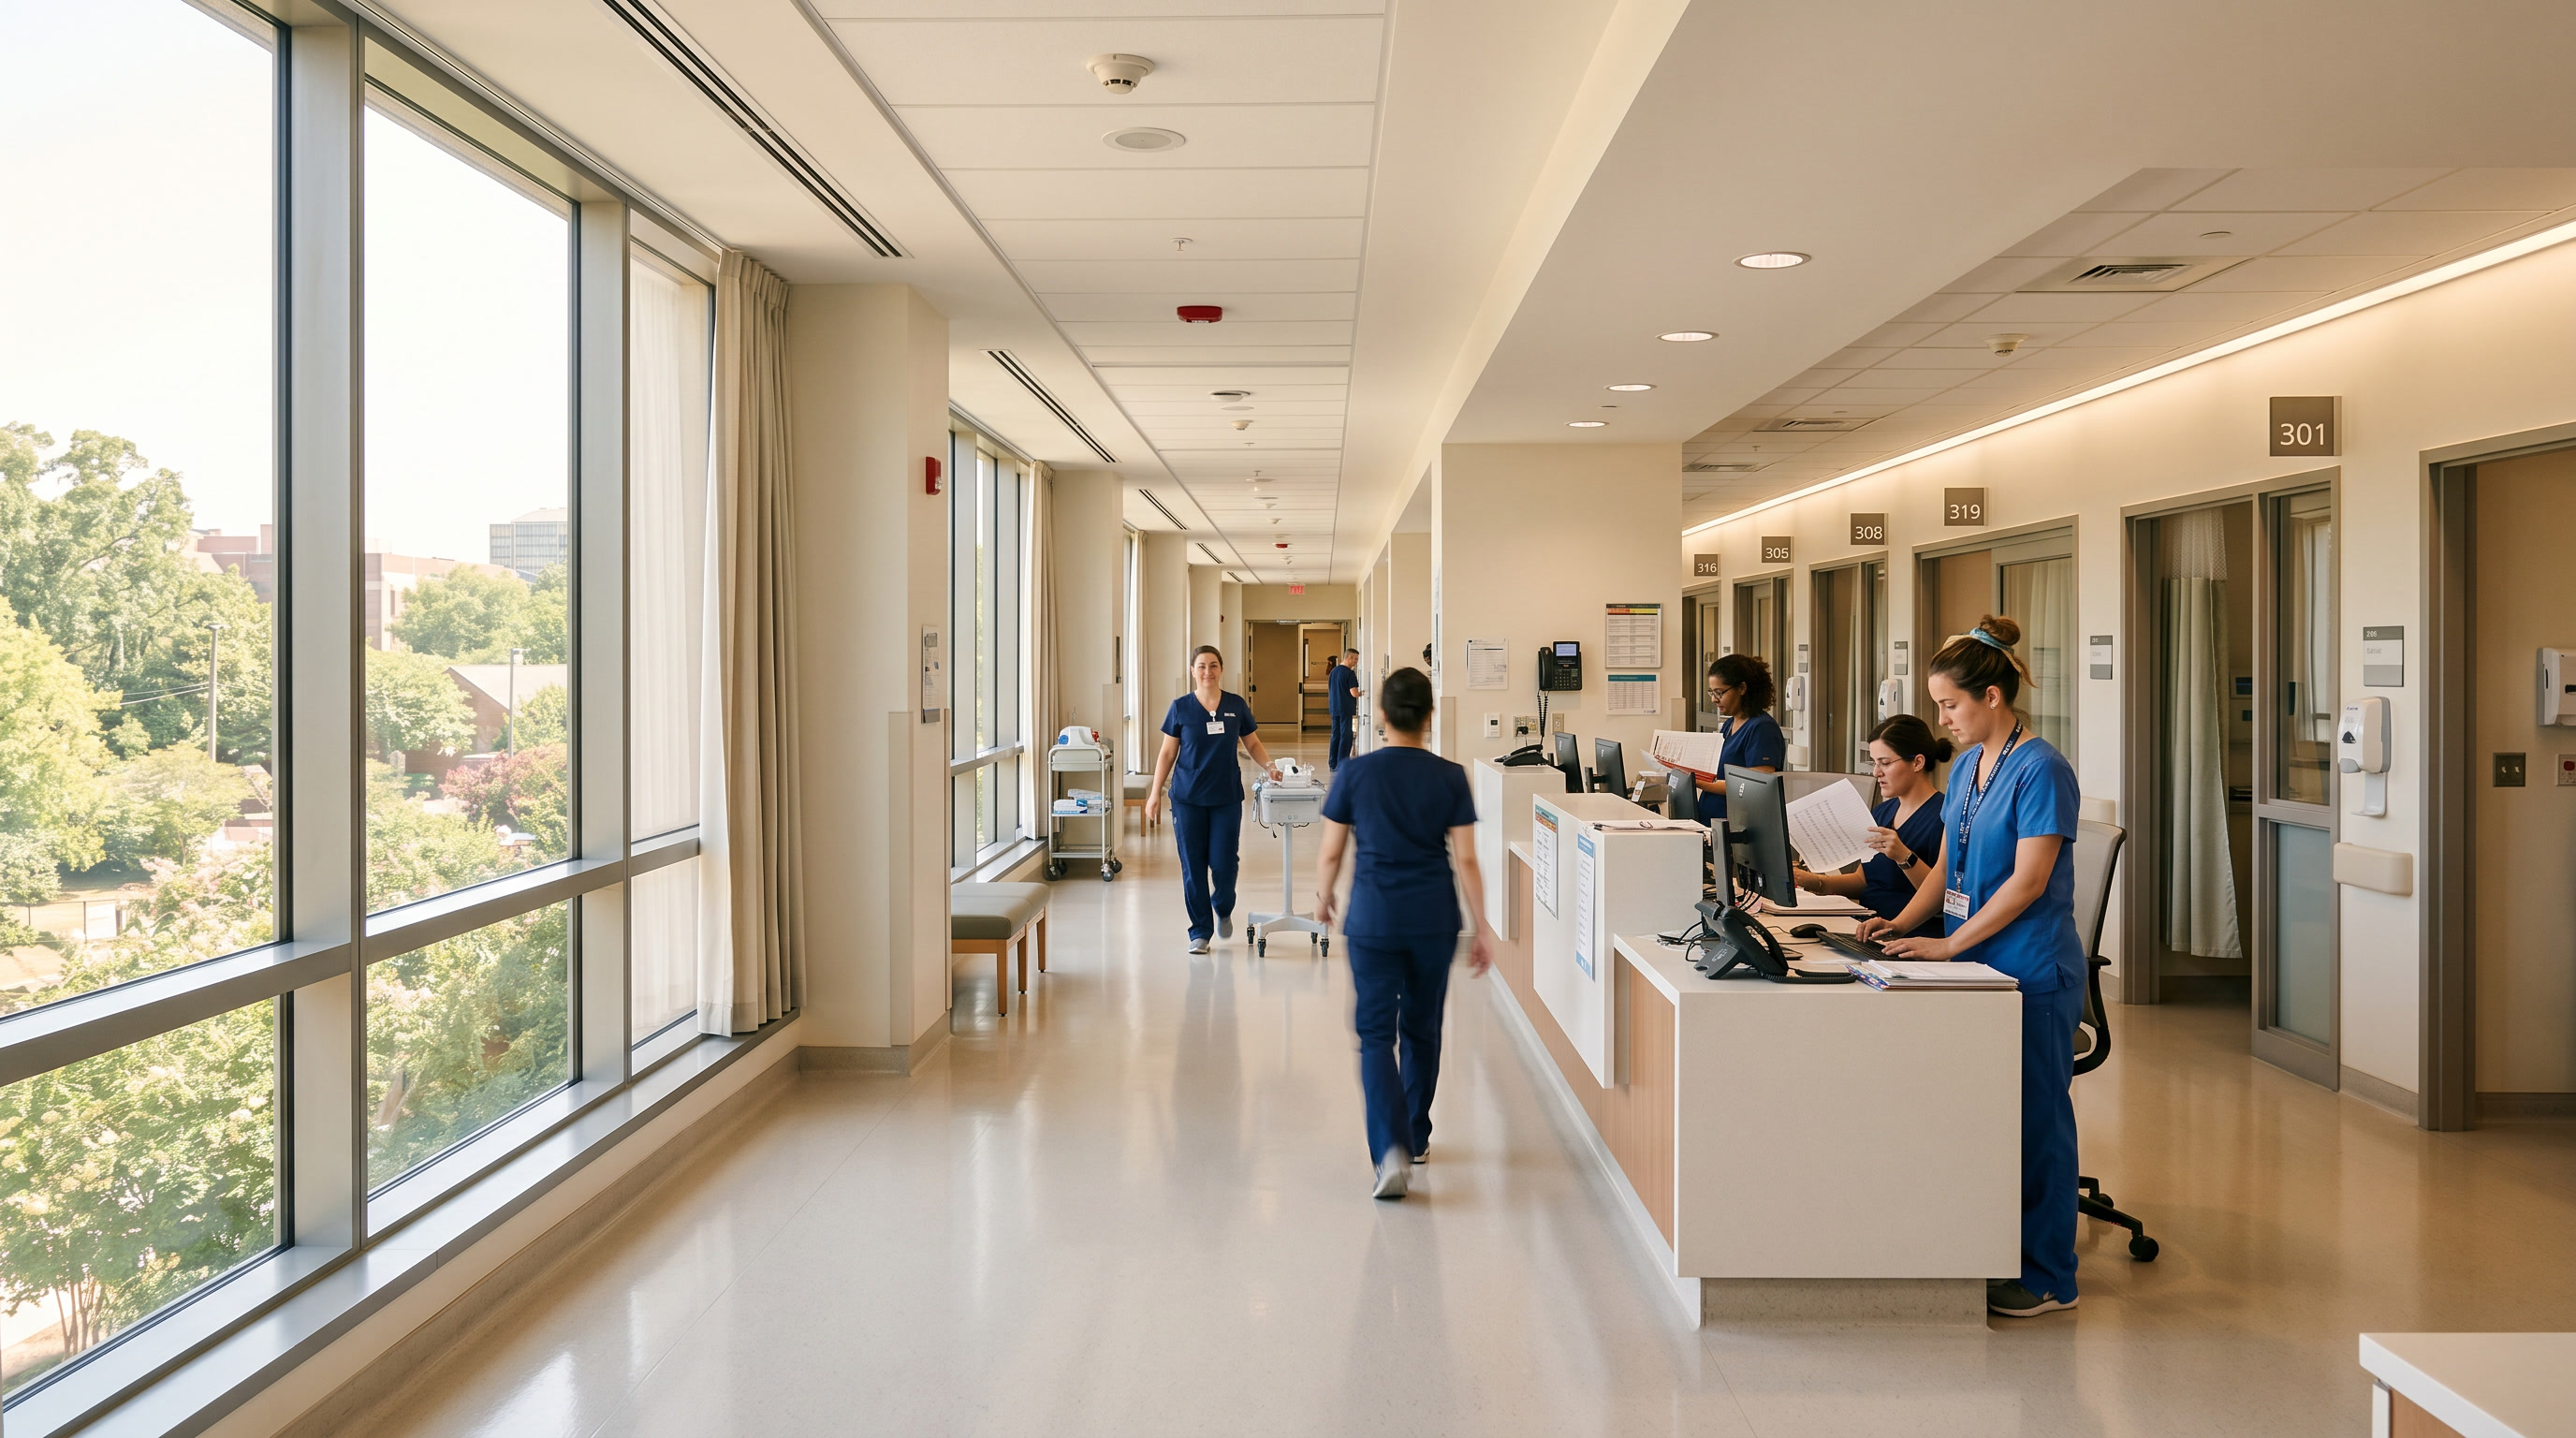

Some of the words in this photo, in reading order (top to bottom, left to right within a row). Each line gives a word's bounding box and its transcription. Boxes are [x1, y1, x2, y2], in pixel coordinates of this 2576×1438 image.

[2280, 422, 2324, 446] 301
[1950, 504, 1981, 520] 319
[1855, 525, 1883, 540] 308
[1765, 547, 1789, 559] 305
[1697, 563, 1718, 573] 316
